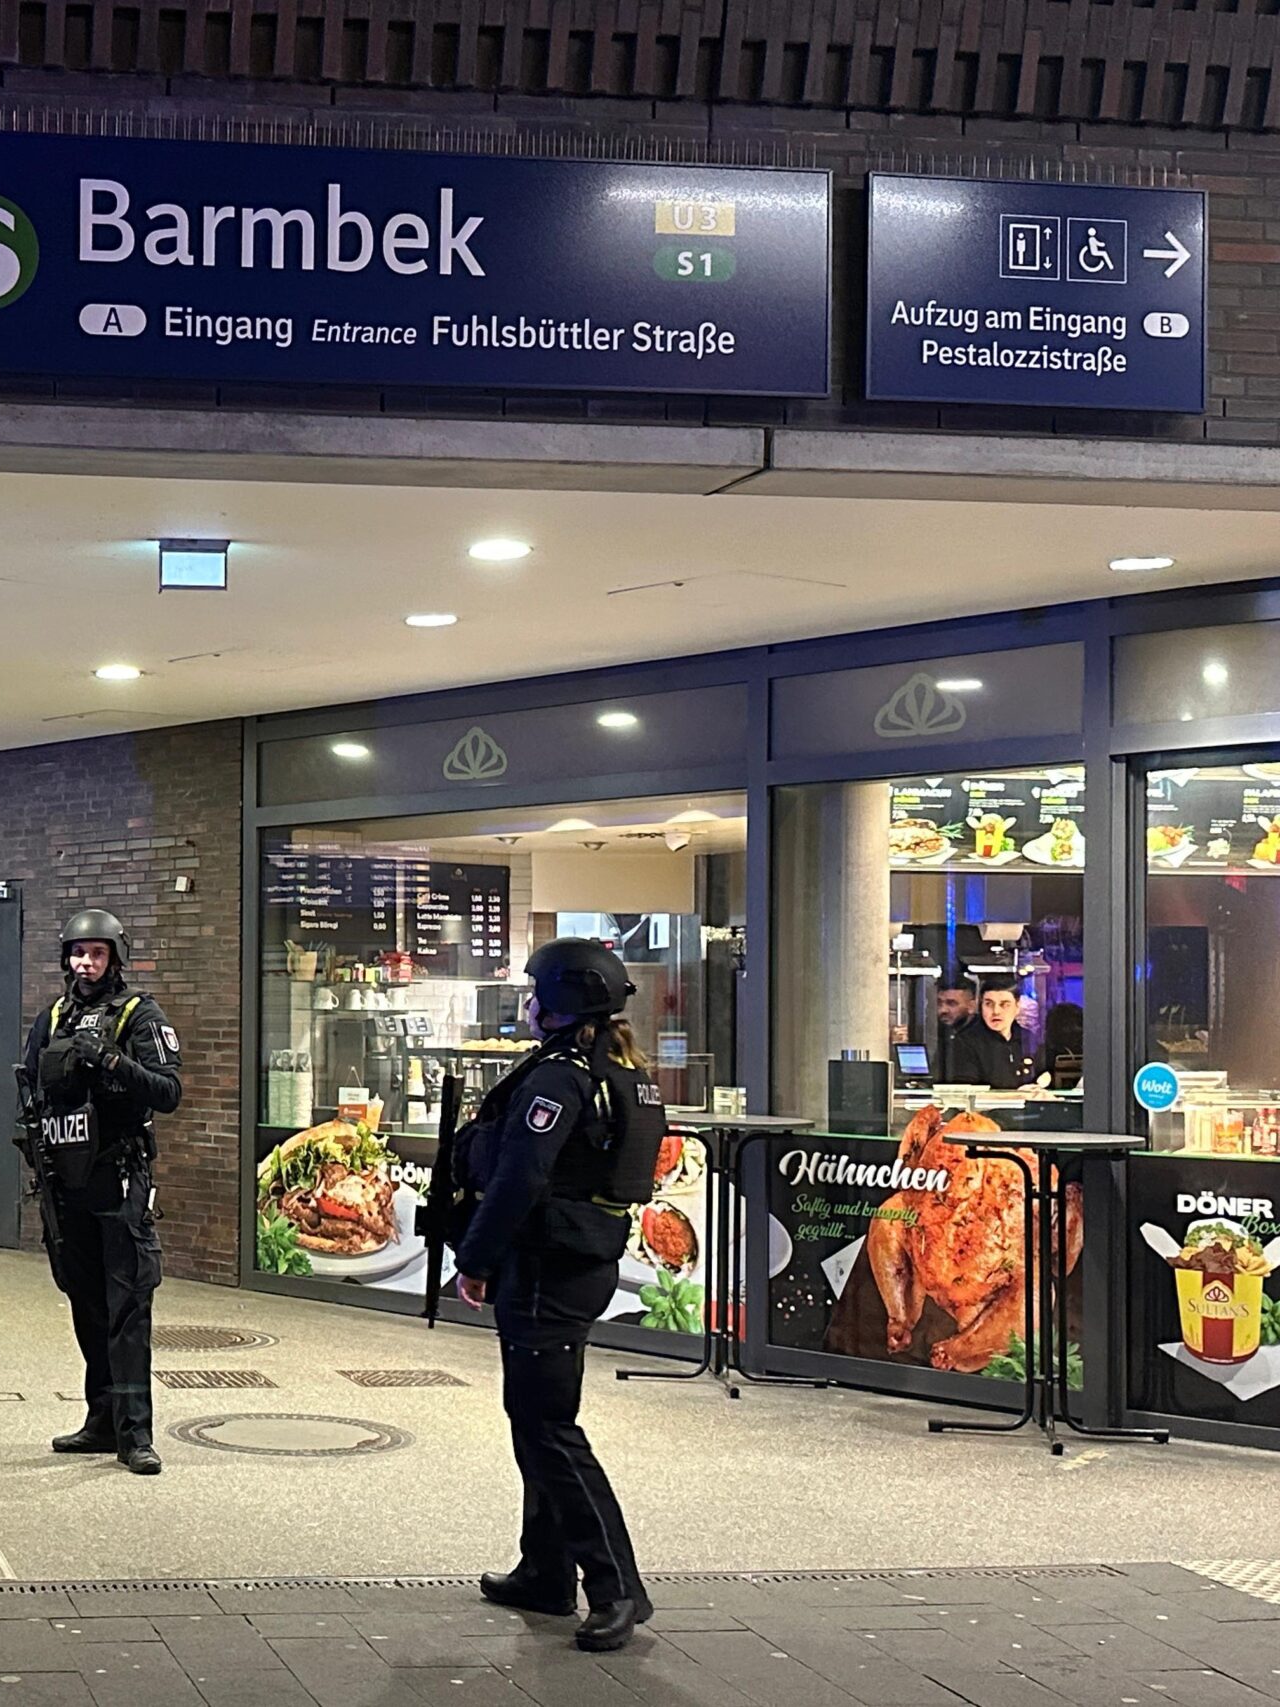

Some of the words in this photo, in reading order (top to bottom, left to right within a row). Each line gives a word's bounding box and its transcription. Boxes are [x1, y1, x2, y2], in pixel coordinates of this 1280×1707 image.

[78, 178, 487, 277] Barmbek
[672, 203, 719, 232] U3
[676, 251, 714, 276] S1
[102, 307, 124, 334] A
[164, 306, 294, 348] Eingang
[311, 318, 417, 347] Entrance
[432, 315, 625, 355] Fuhlsbüttler
[631, 320, 735, 358] Straße
[891, 300, 979, 335] Aufzug
[984, 310, 1023, 332] am
[1028, 307, 1128, 342] Eingang
[1159, 314, 1173, 334] B
[922, 341, 1129, 376] Pestalozzistraße
[1141, 1079, 1173, 1095] Wolt
[41, 1112, 89, 1145] POLIZEI
[778, 1149, 951, 1193] Hähnchen
[790, 1194, 832, 1220] Saftig
[833, 1200, 861, 1217] und
[862, 1201, 920, 1227] knusprig
[1176, 1190, 1275, 1219] DÖNER
